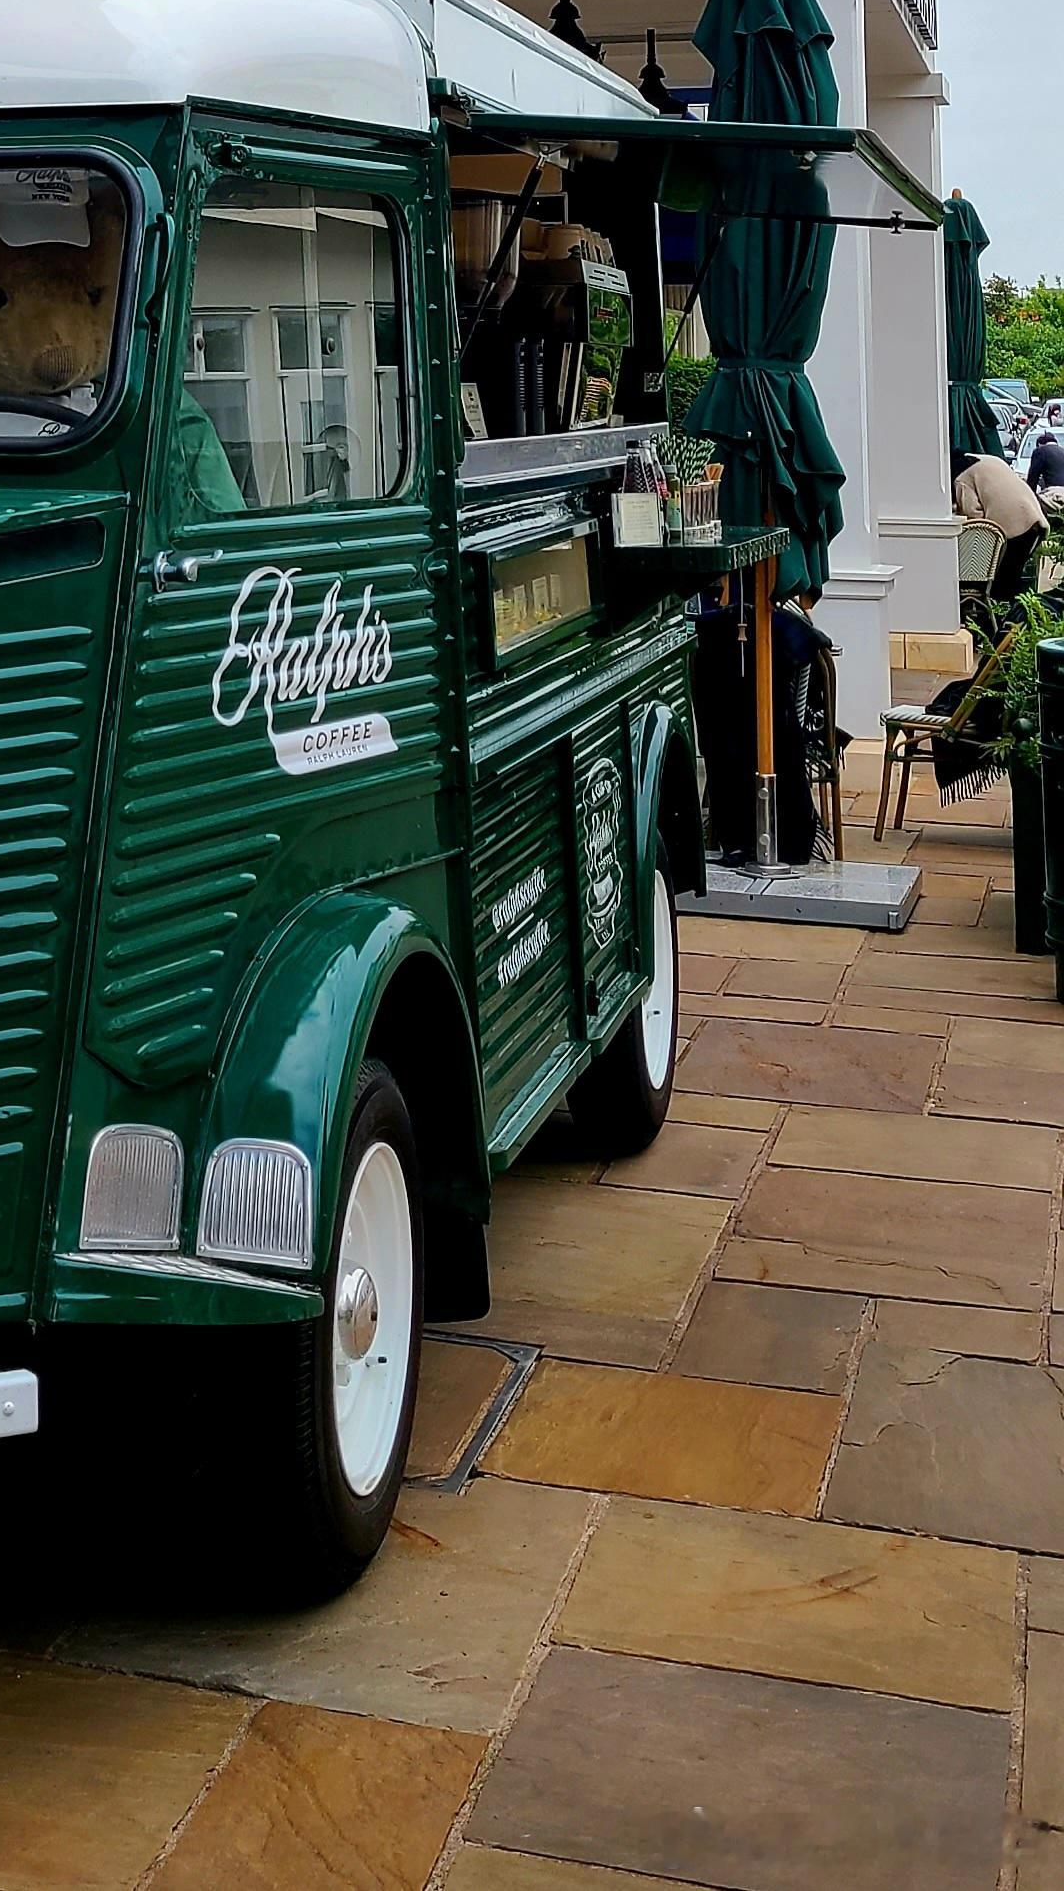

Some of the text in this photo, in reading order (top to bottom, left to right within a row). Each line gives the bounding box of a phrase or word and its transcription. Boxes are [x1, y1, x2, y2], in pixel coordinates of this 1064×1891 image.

[212, 566, 392, 726] Ralph's
[302, 721, 374, 753] COFFEE
[335, 744, 368, 759] LAUREN
[492, 865, 547, 934] @ralphscoffee
[497, 918, 550, 989] #ralphscoffee
